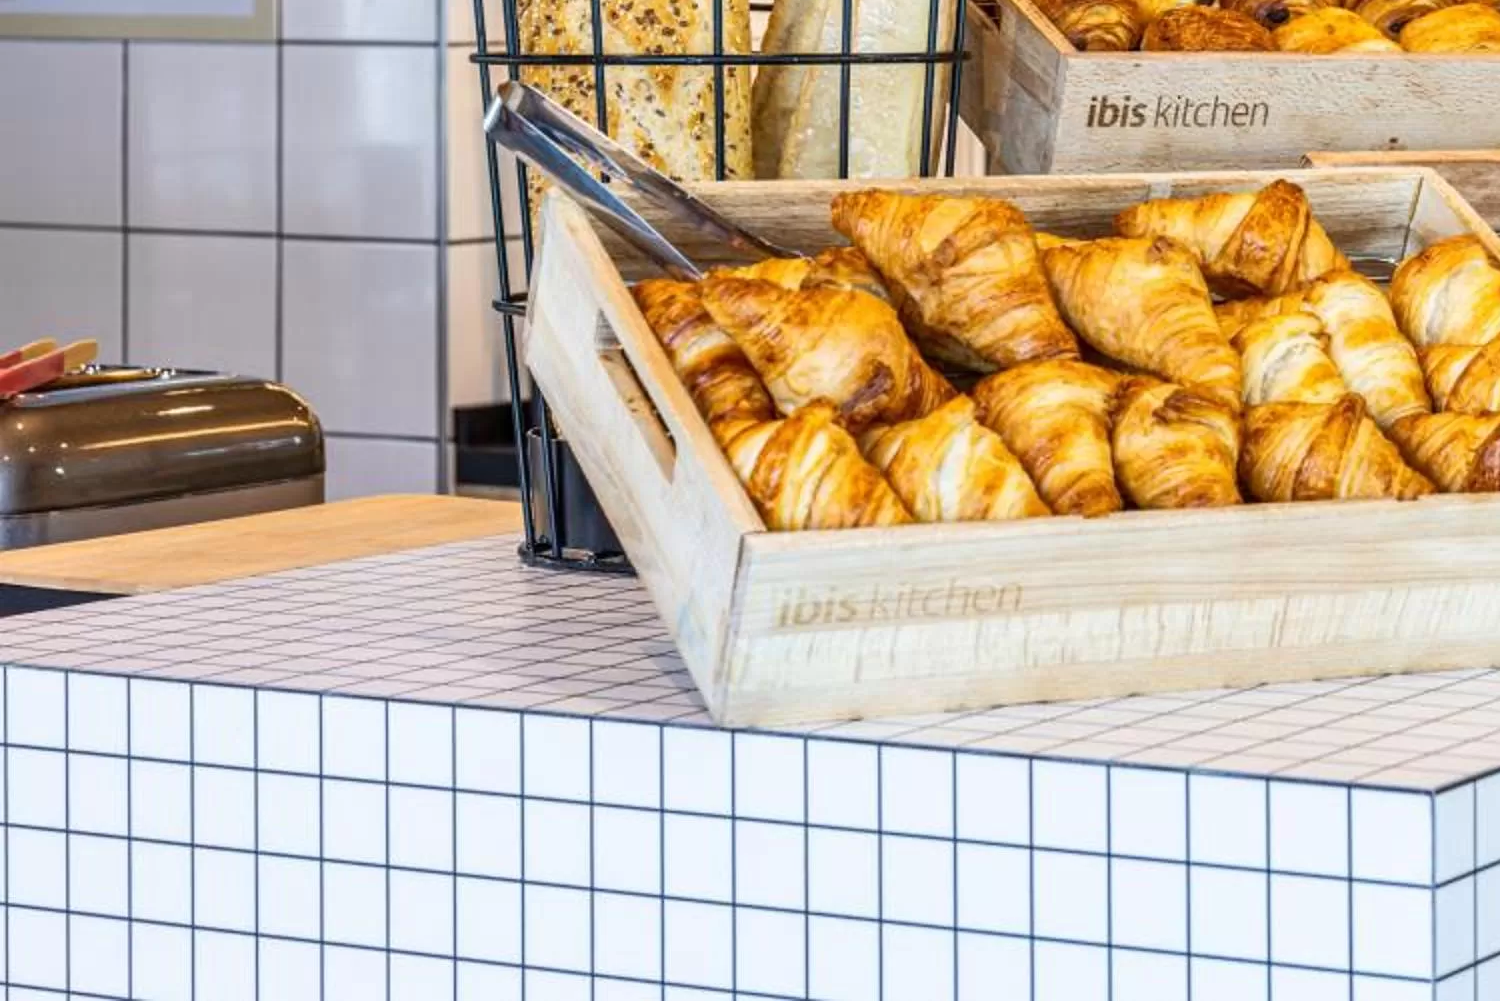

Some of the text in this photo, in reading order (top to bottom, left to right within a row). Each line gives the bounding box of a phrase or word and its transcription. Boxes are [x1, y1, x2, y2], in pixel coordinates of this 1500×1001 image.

[1086, 95, 1270, 128] ibis kitchen
[777, 577, 1024, 628] ibis kitchen
